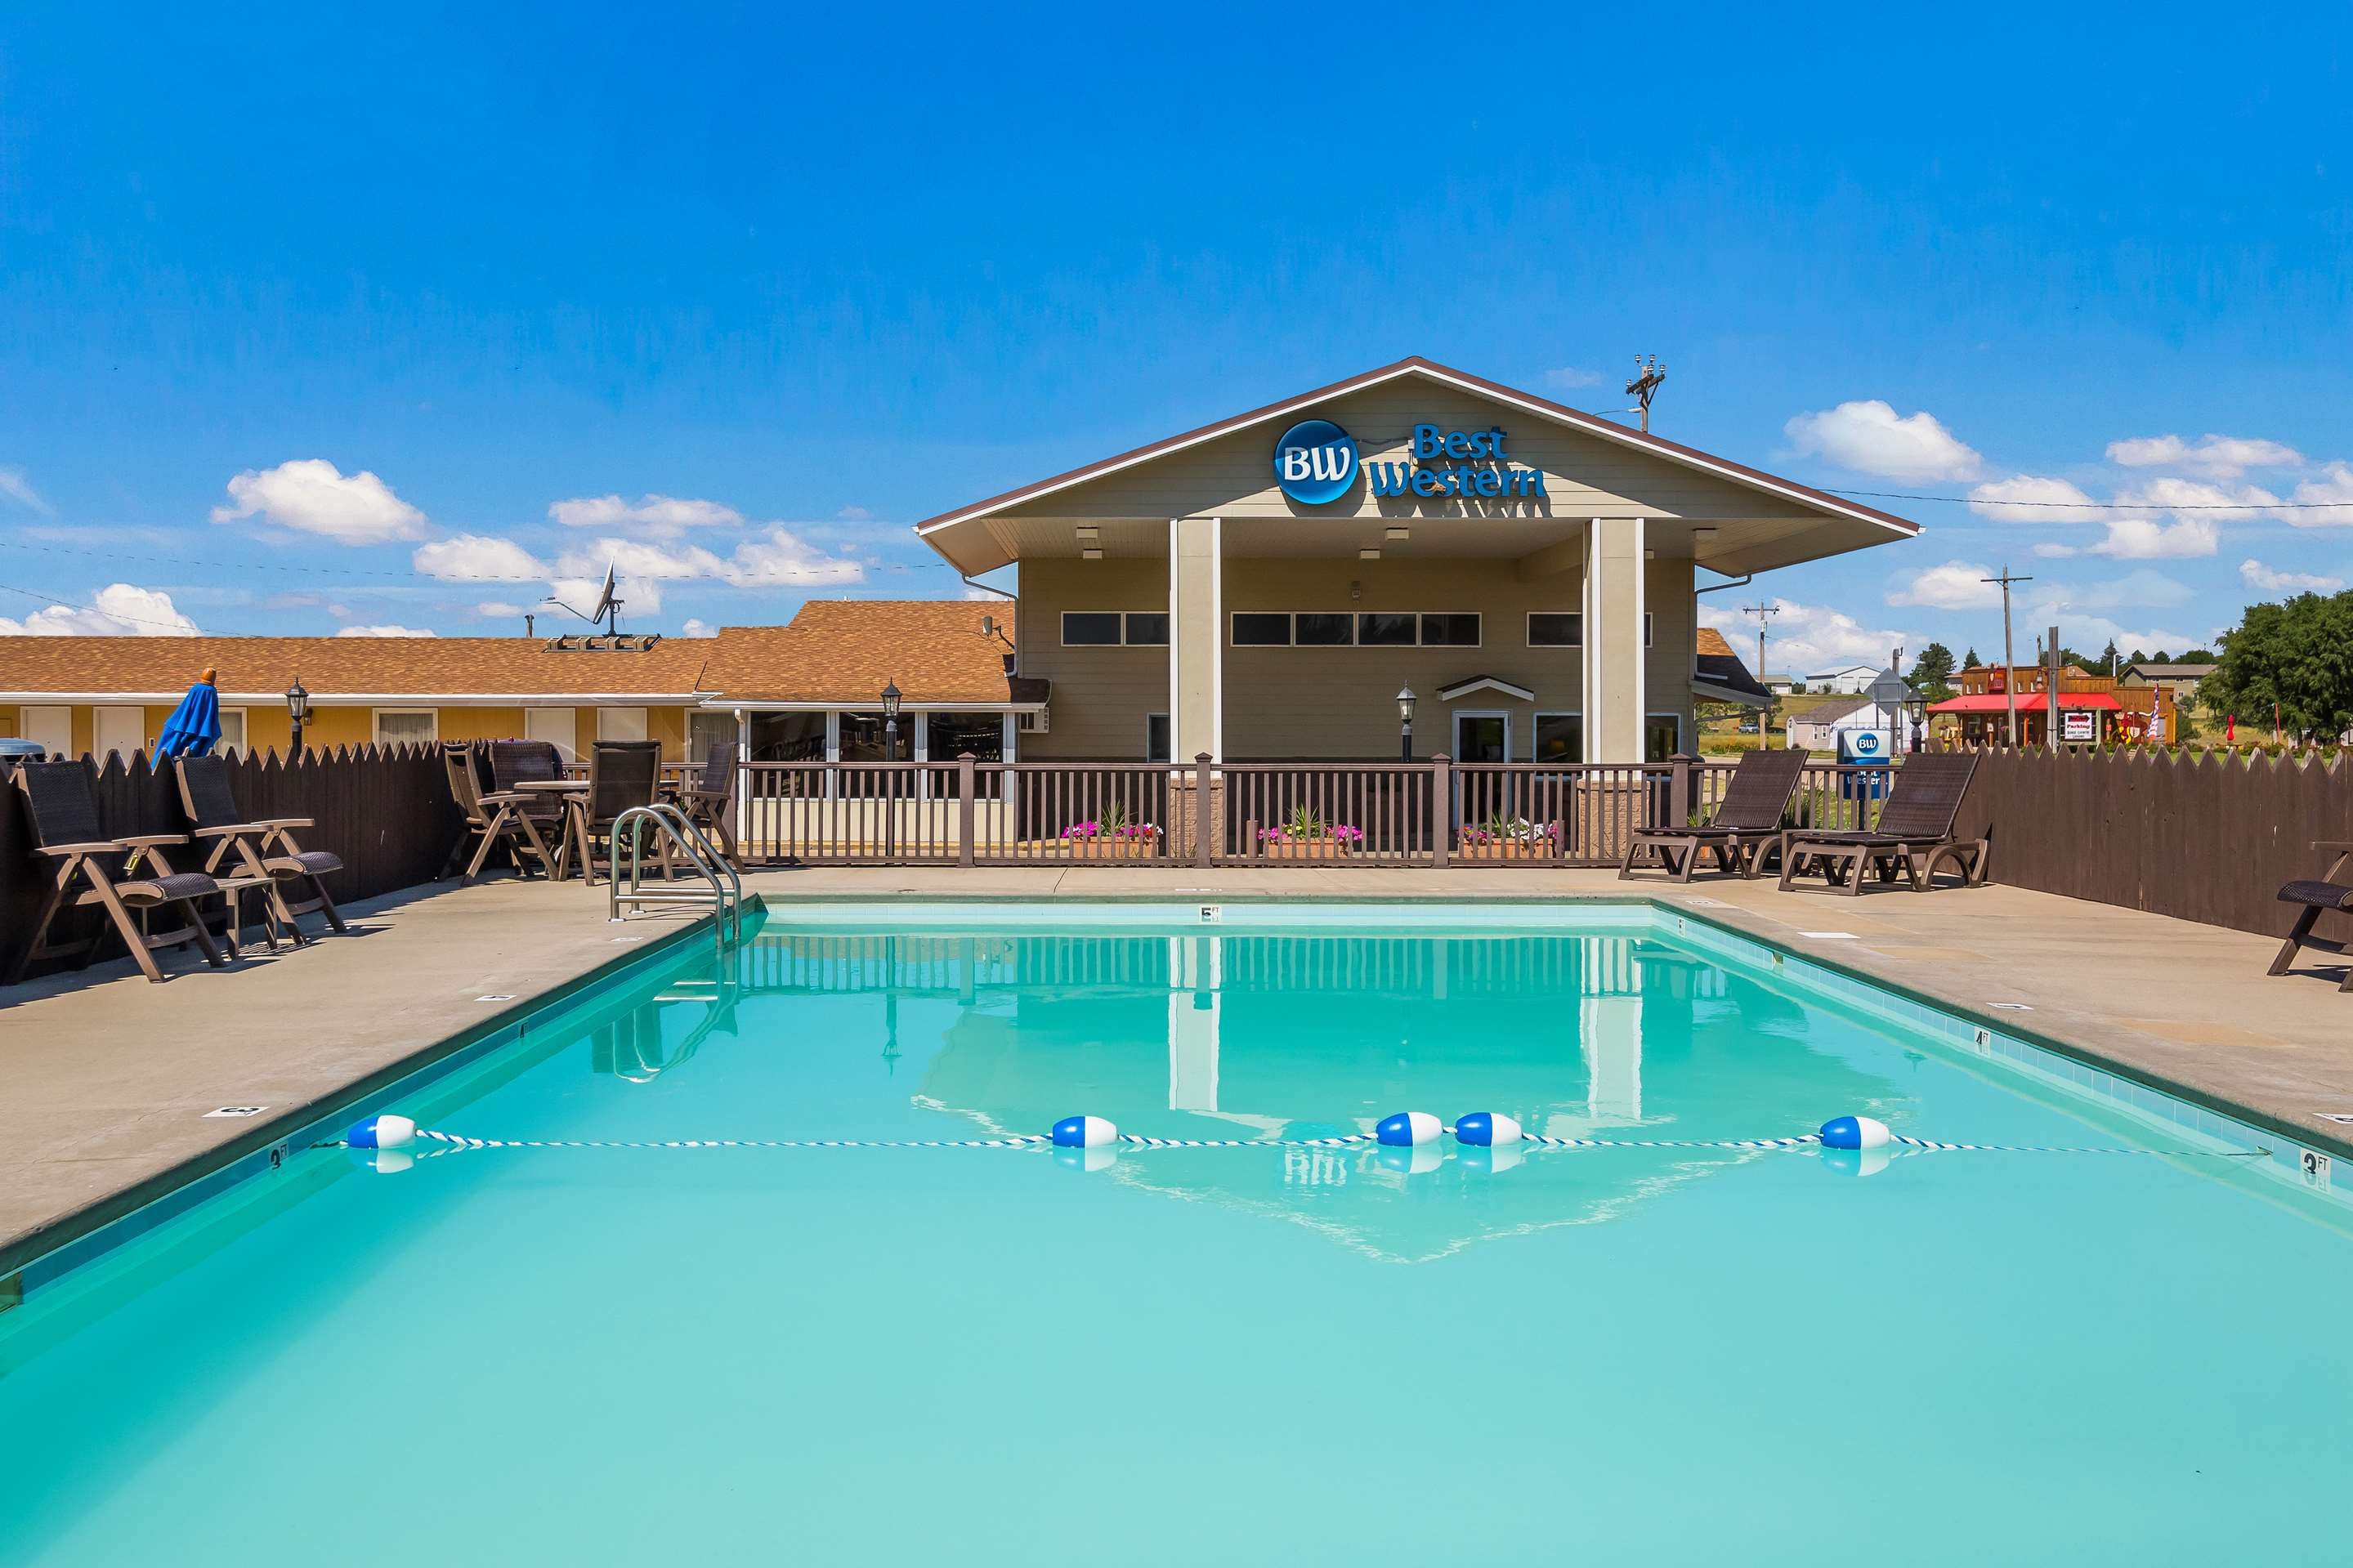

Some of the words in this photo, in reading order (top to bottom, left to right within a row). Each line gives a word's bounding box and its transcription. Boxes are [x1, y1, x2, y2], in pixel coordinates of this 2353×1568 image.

[1414, 423, 1510, 459] Best
[1284, 446, 1351, 482] BW
[1369, 462, 1546, 498] Western
[1859, 739, 1877, 749] BW
[1847, 775, 1889, 784] eser
[1976, 1030, 1983, 1045] 4
[2304, 1153, 2316, 1174] 3
[2318, 1156, 2328, 1171] FT
